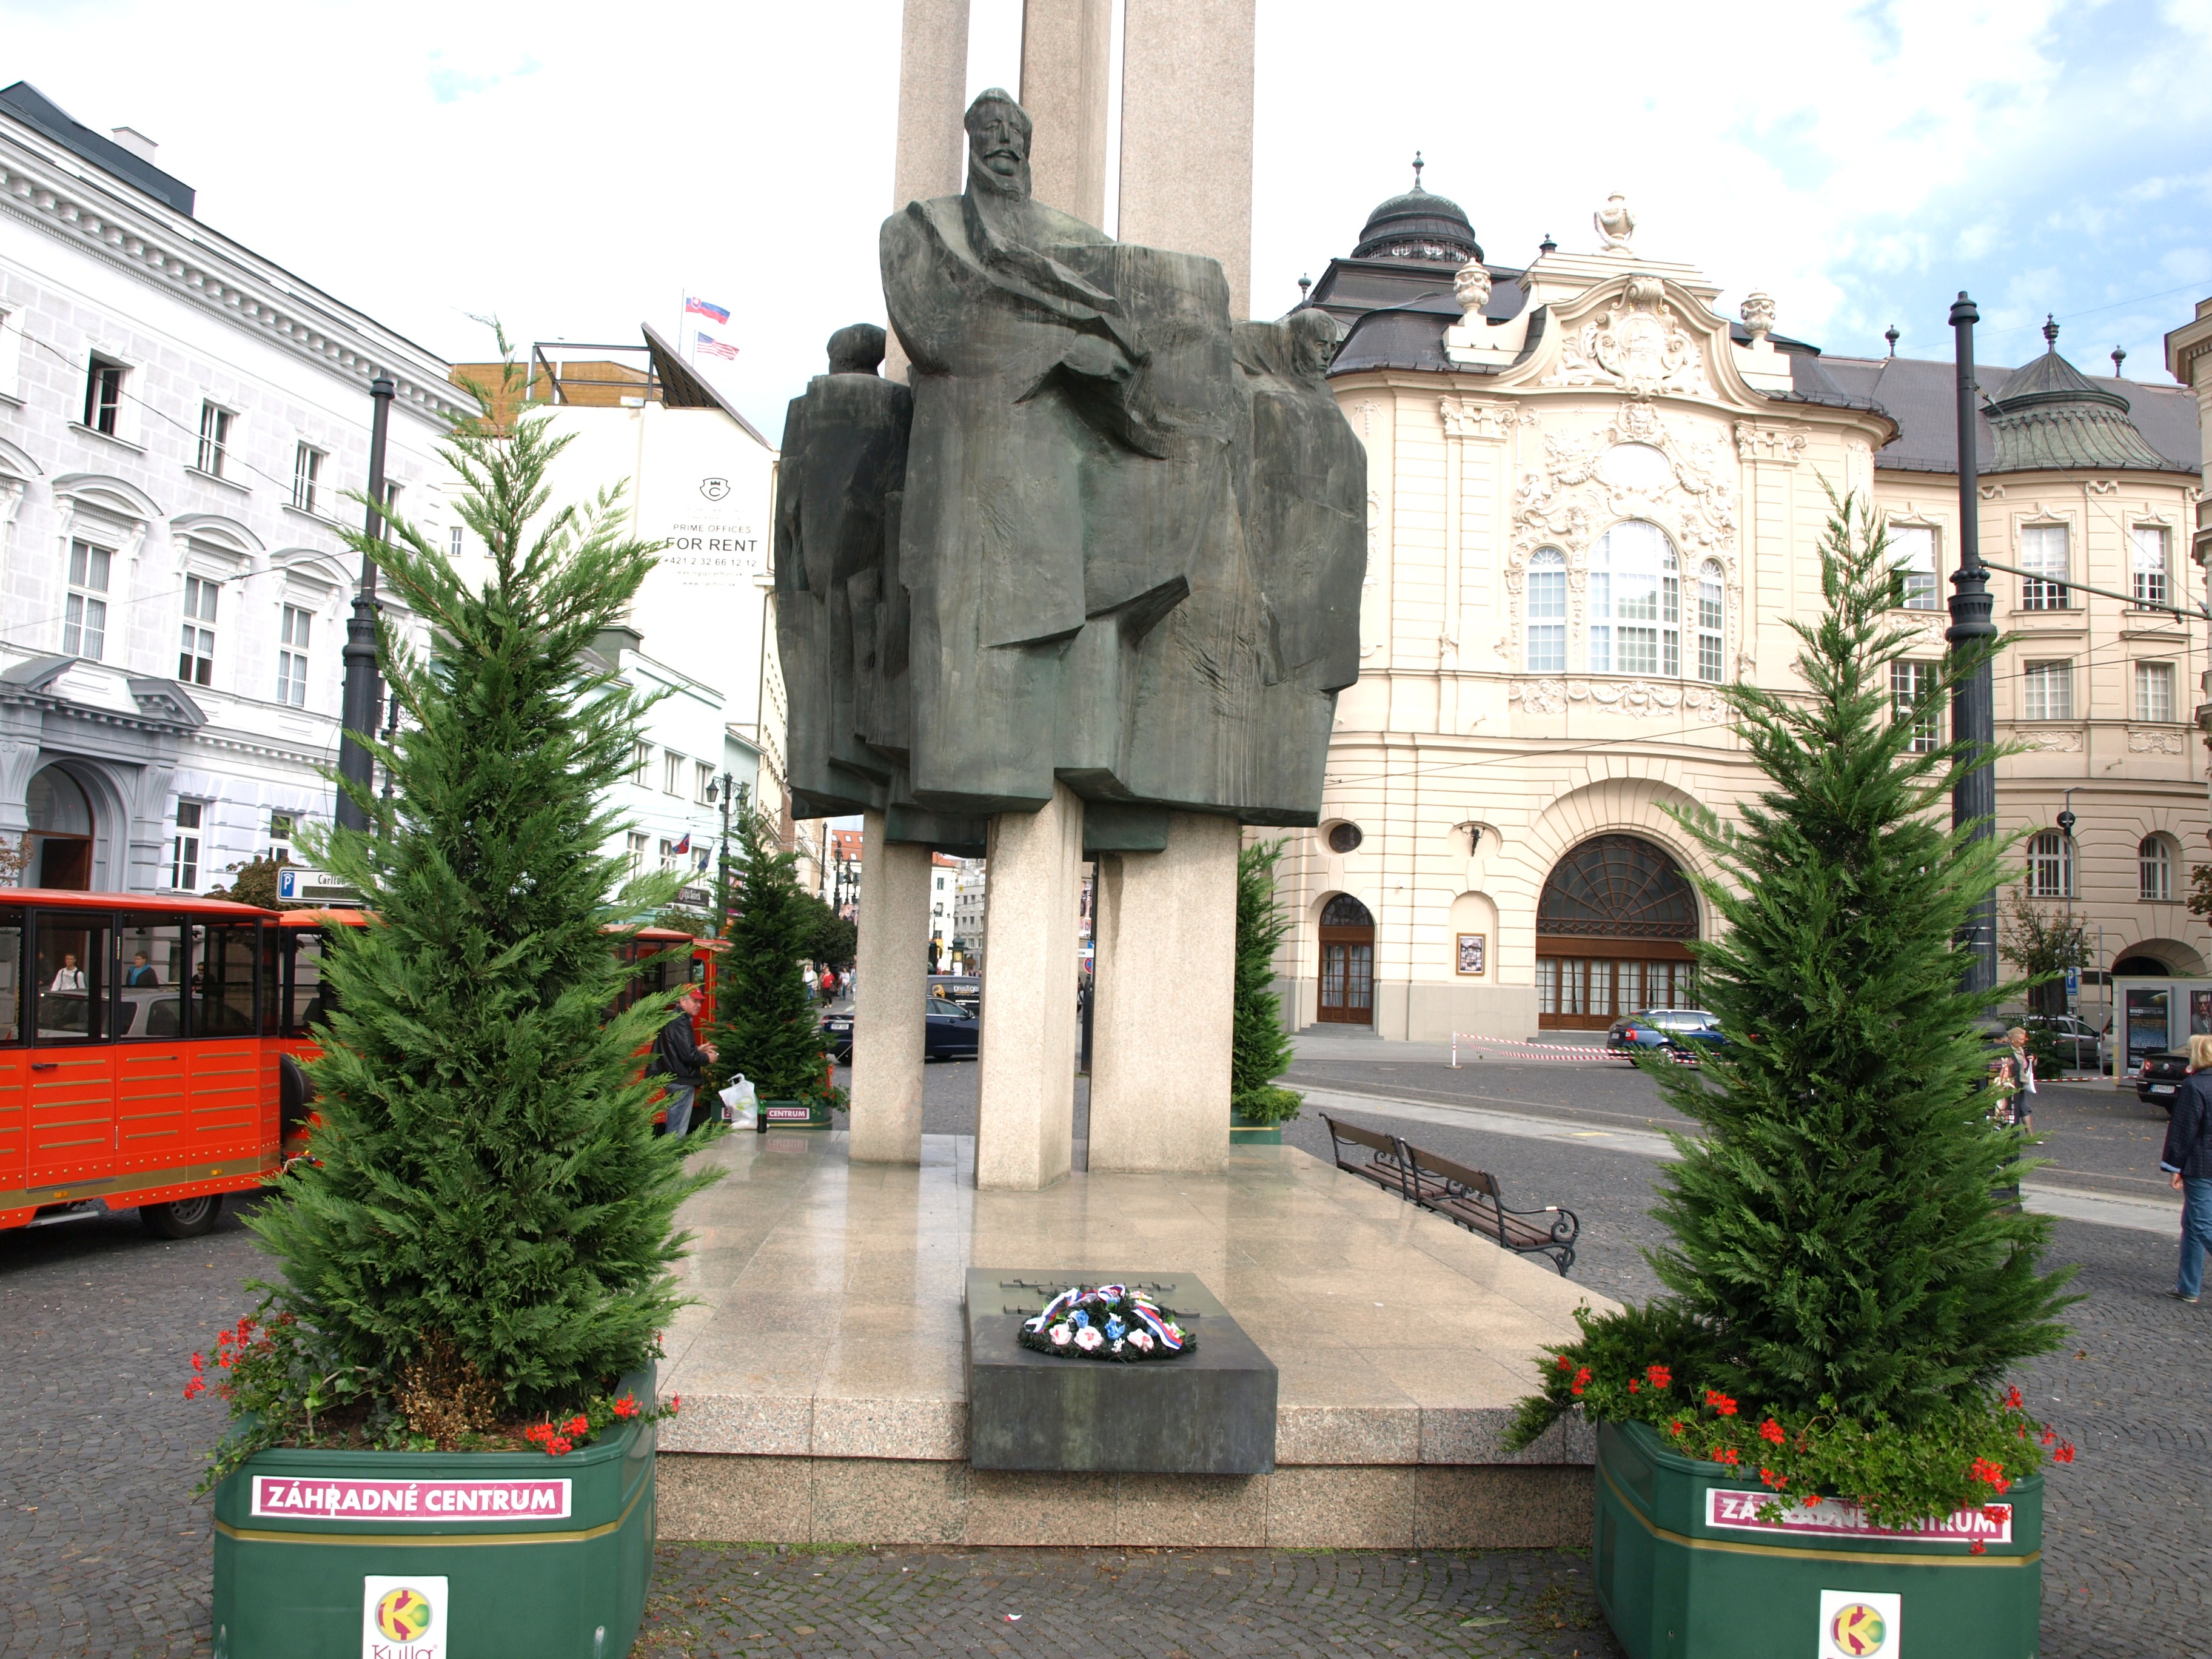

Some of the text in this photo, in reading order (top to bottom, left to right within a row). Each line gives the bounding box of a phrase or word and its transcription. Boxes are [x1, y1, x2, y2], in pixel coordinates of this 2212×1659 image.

[708, 525, 751, 534] OFFICES
[666, 537, 758, 552] FOR RENT
[318, 874, 346, 885] Carlton
[267, 1481, 556, 1512] ZÁHRADNÉ CENTRUM
[1879, 1509, 1997, 1533] NTRUM
